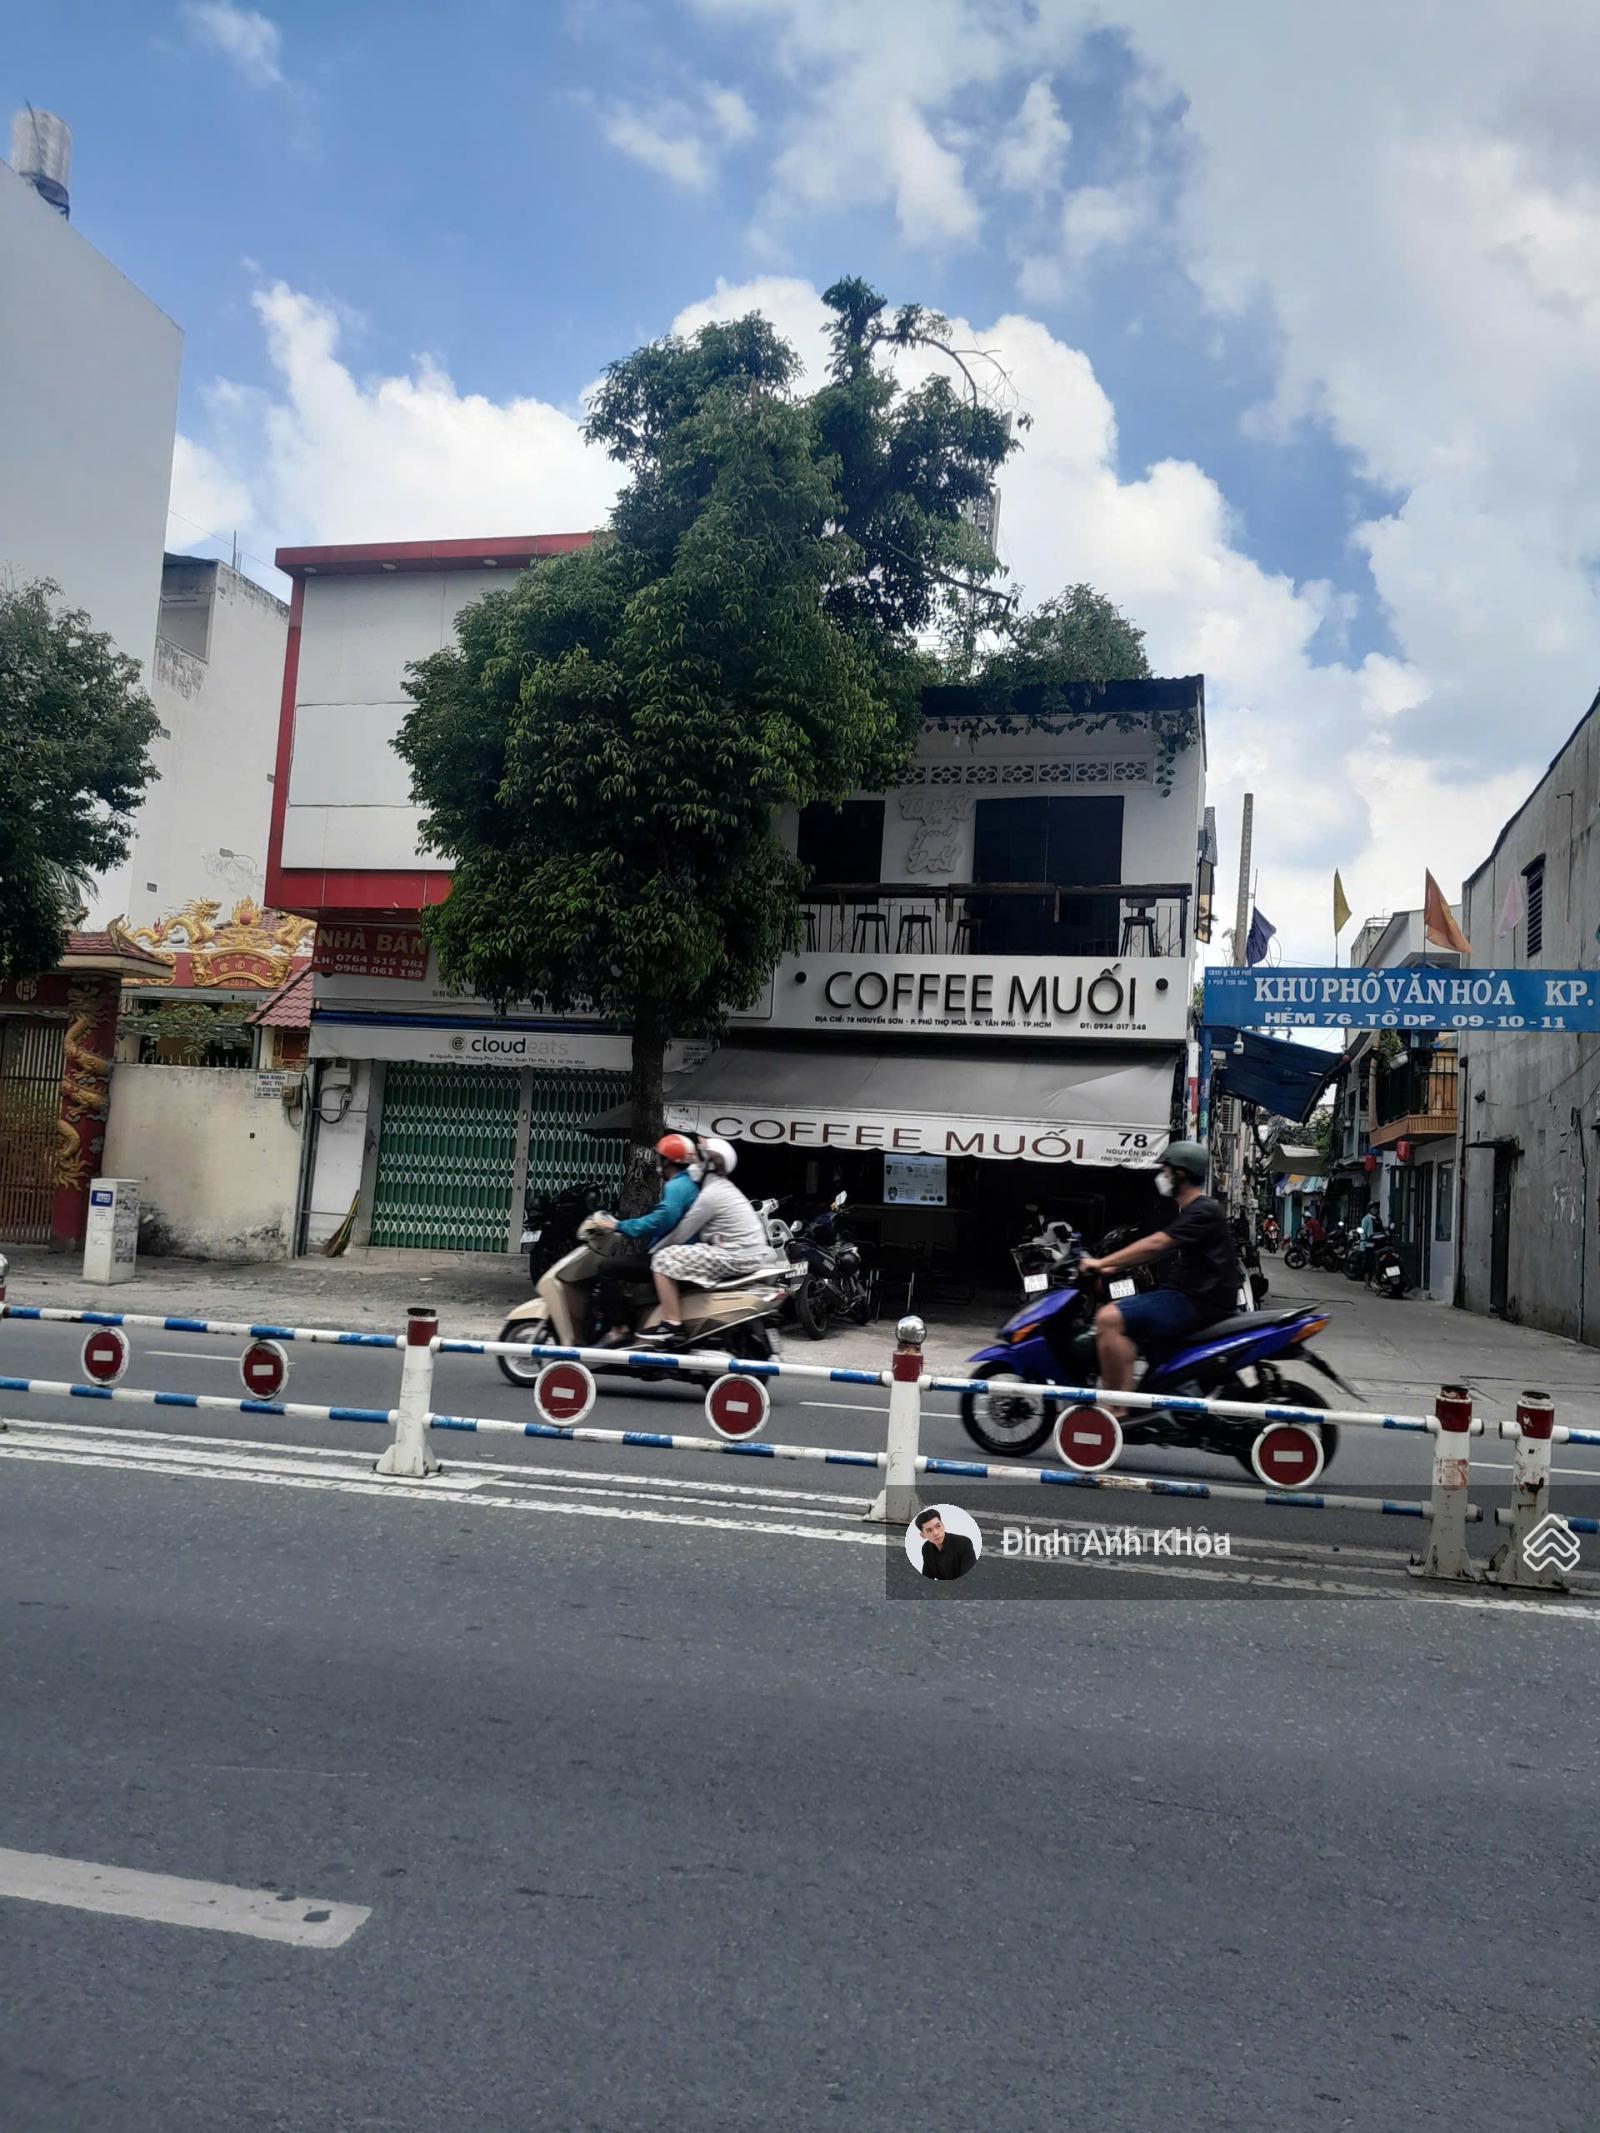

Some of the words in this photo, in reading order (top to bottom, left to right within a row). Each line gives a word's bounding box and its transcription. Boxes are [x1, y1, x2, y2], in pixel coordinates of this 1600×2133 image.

[317, 927, 367, 950] NHÀ
[376, 931, 427, 955] BÁN
[313, 956, 334, 965] LH:
[336, 954, 368, 963] 0764
[373, 956, 397, 966] 515
[335, 963, 368, 973] 0968
[371, 966, 394, 976] 061
[400, 969, 423, 978] 199
[824, 971, 994, 1014] COFFEE
[1008, 962, 1137, 1017] MUỐI
[1254, 977, 1318, 1003] KHU
[1321, 970, 1385, 1005] PHỐ
[1384, 972, 1447, 1005] VĂN
[1450, 970, 1516, 1006] HÓA
[1545, 980, 1594, 1007] KP.
[815, 1015, 828, 1024] ĐỊA
[829, 1014, 845, 1024] CHỈ:
[846, 1016, 855, 1024] 78
[857, 1015, 886, 1025] NGUYỄN
[888, 1017, 904, 1025] SƠN
[918, 1017, 933, 1026] PHÚ
[935, 1019, 950, 1028] THỌ
[985, 1018, 999, 1027] TÂN
[1001, 1019, 1016, 1028] PHÚ
[1265, 1007, 1316, 1025] HẺM
[1323, 1013, 1352, 1025] 76
[1403, 1014, 1436, 1027] DP
[1093, 1022, 1114, 1031] 0934
[1116, 1023, 1130, 1031] 017
[1131, 1023, 1147, 1031] 248
[471, 1036, 569, 1056] cloudeats
[711, 1117, 922, 1149] COFFEE
[945, 1128, 1084, 1160] MUỐI
[1118, 1132, 1148, 1148] 78
[1106, 1148, 1139, 1157] NGUYỄN
